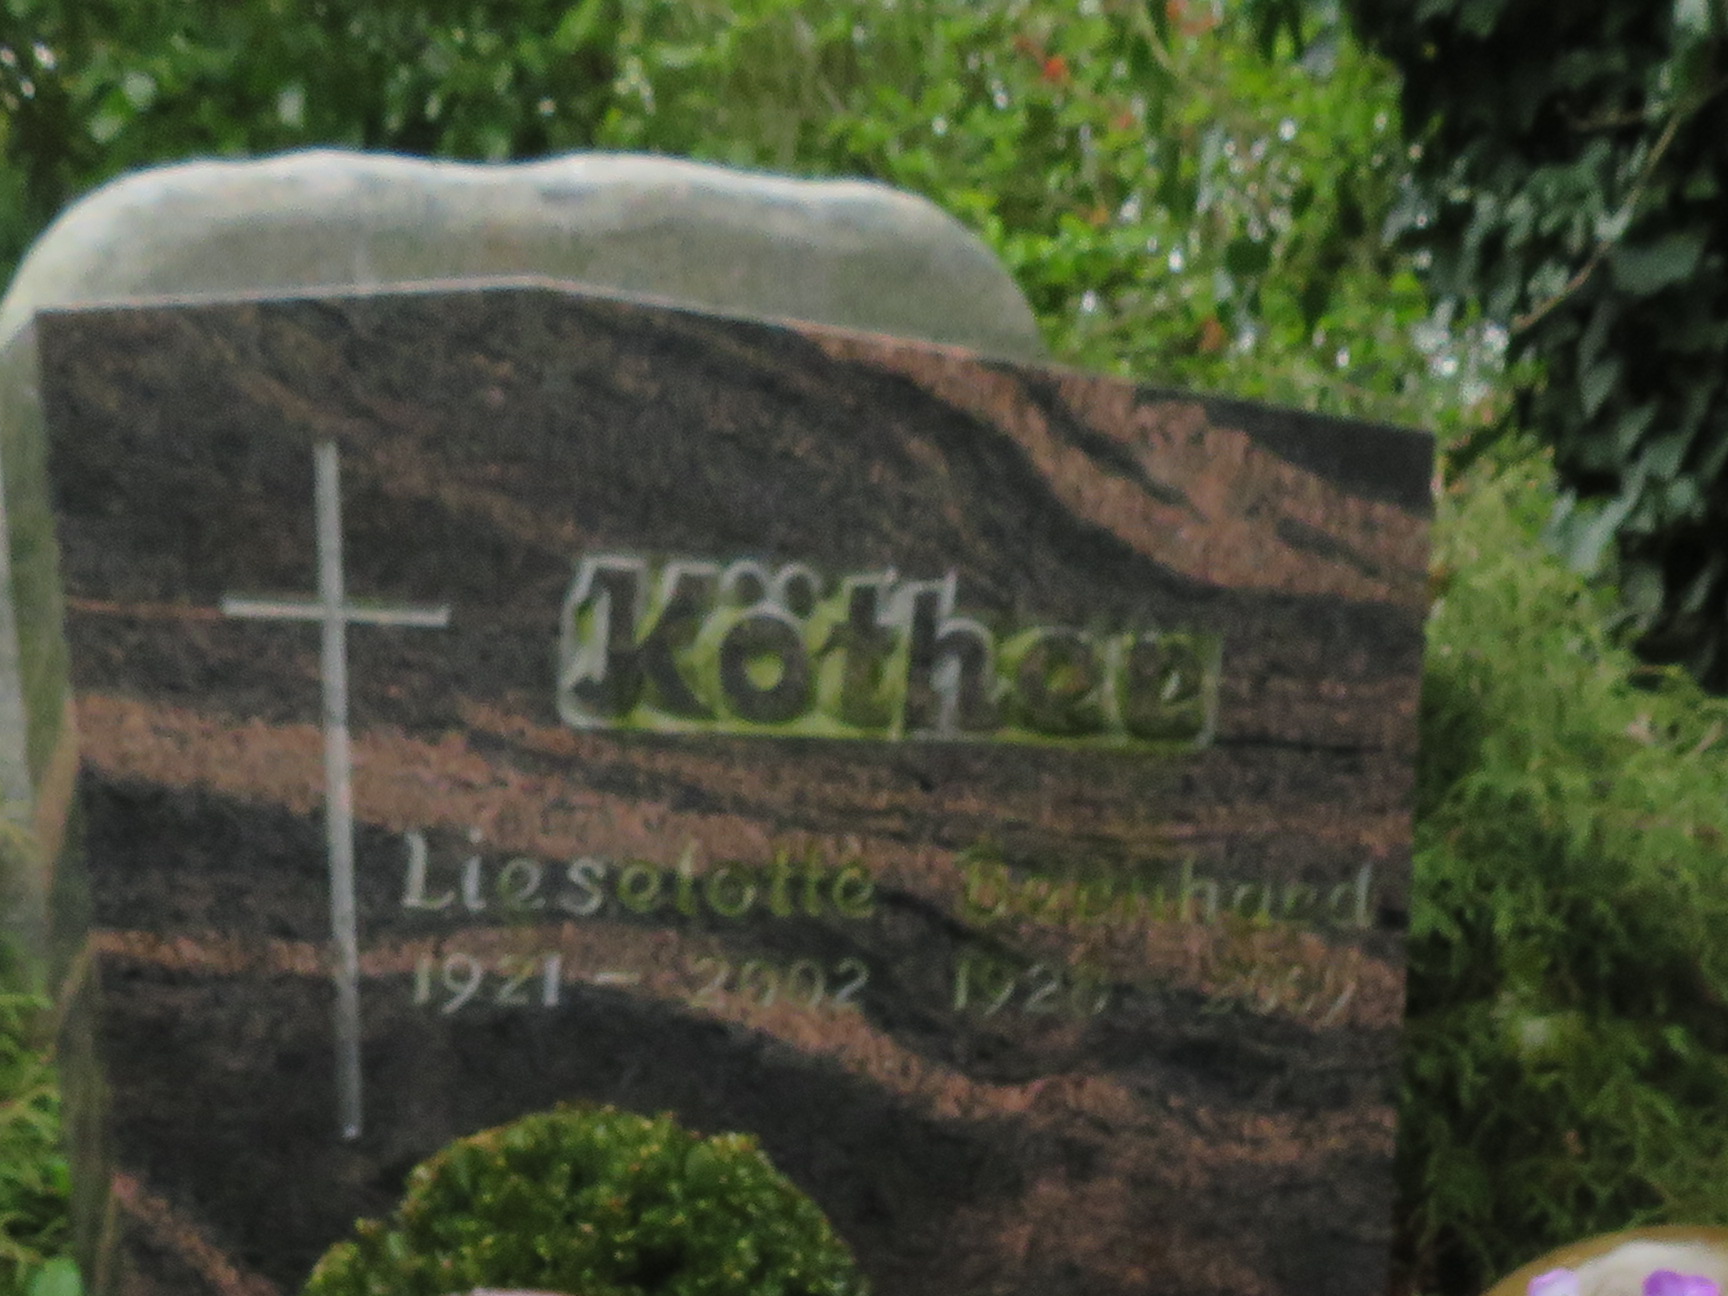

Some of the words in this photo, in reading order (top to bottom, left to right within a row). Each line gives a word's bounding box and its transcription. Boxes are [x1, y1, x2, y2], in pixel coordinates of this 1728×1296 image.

[400, 828, 874, 918] Lieselotte
[414, 952, 562, 1013] 1921
[687, 957, 870, 1009] 2002
